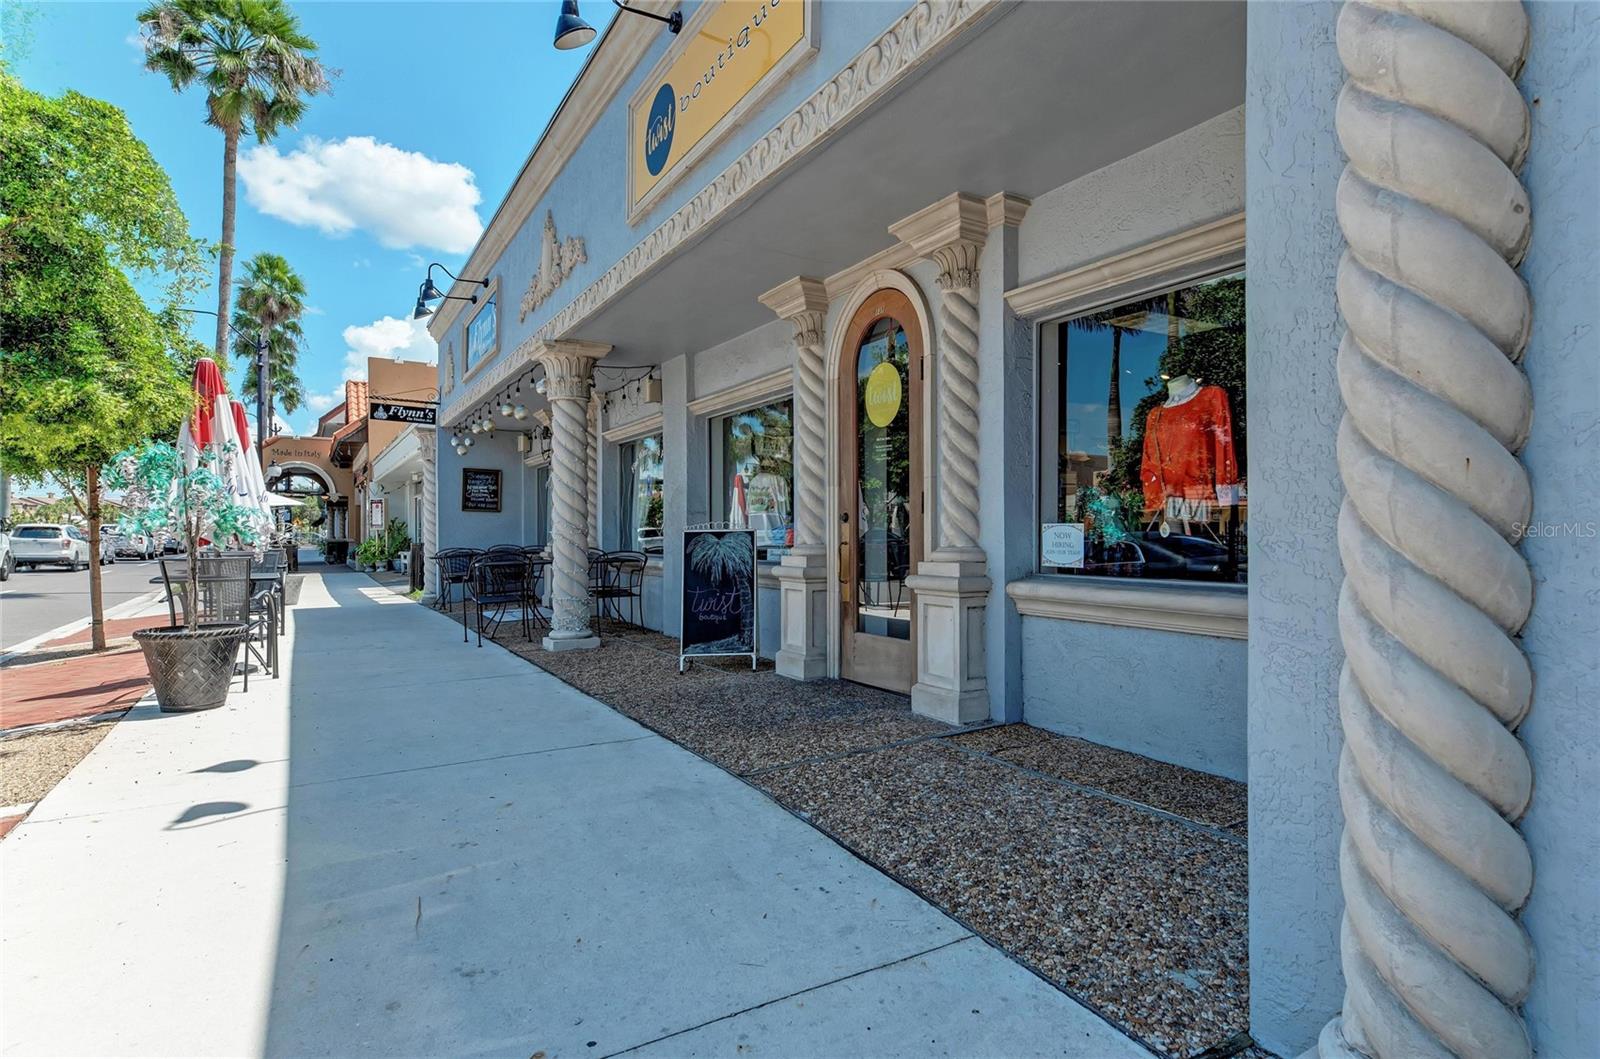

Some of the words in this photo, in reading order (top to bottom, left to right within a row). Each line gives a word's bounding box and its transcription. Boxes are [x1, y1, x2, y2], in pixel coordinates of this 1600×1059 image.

[646, 103, 676, 155] twist
[388, 405, 434, 419] Flynn's
[272, 448, 293, 457] Made
[303, 449, 321, 459] Italy
[1054, 532, 1072, 540] NOW
[1051, 541, 1075, 549] HIRING
[687, 586, 744, 615] twist
